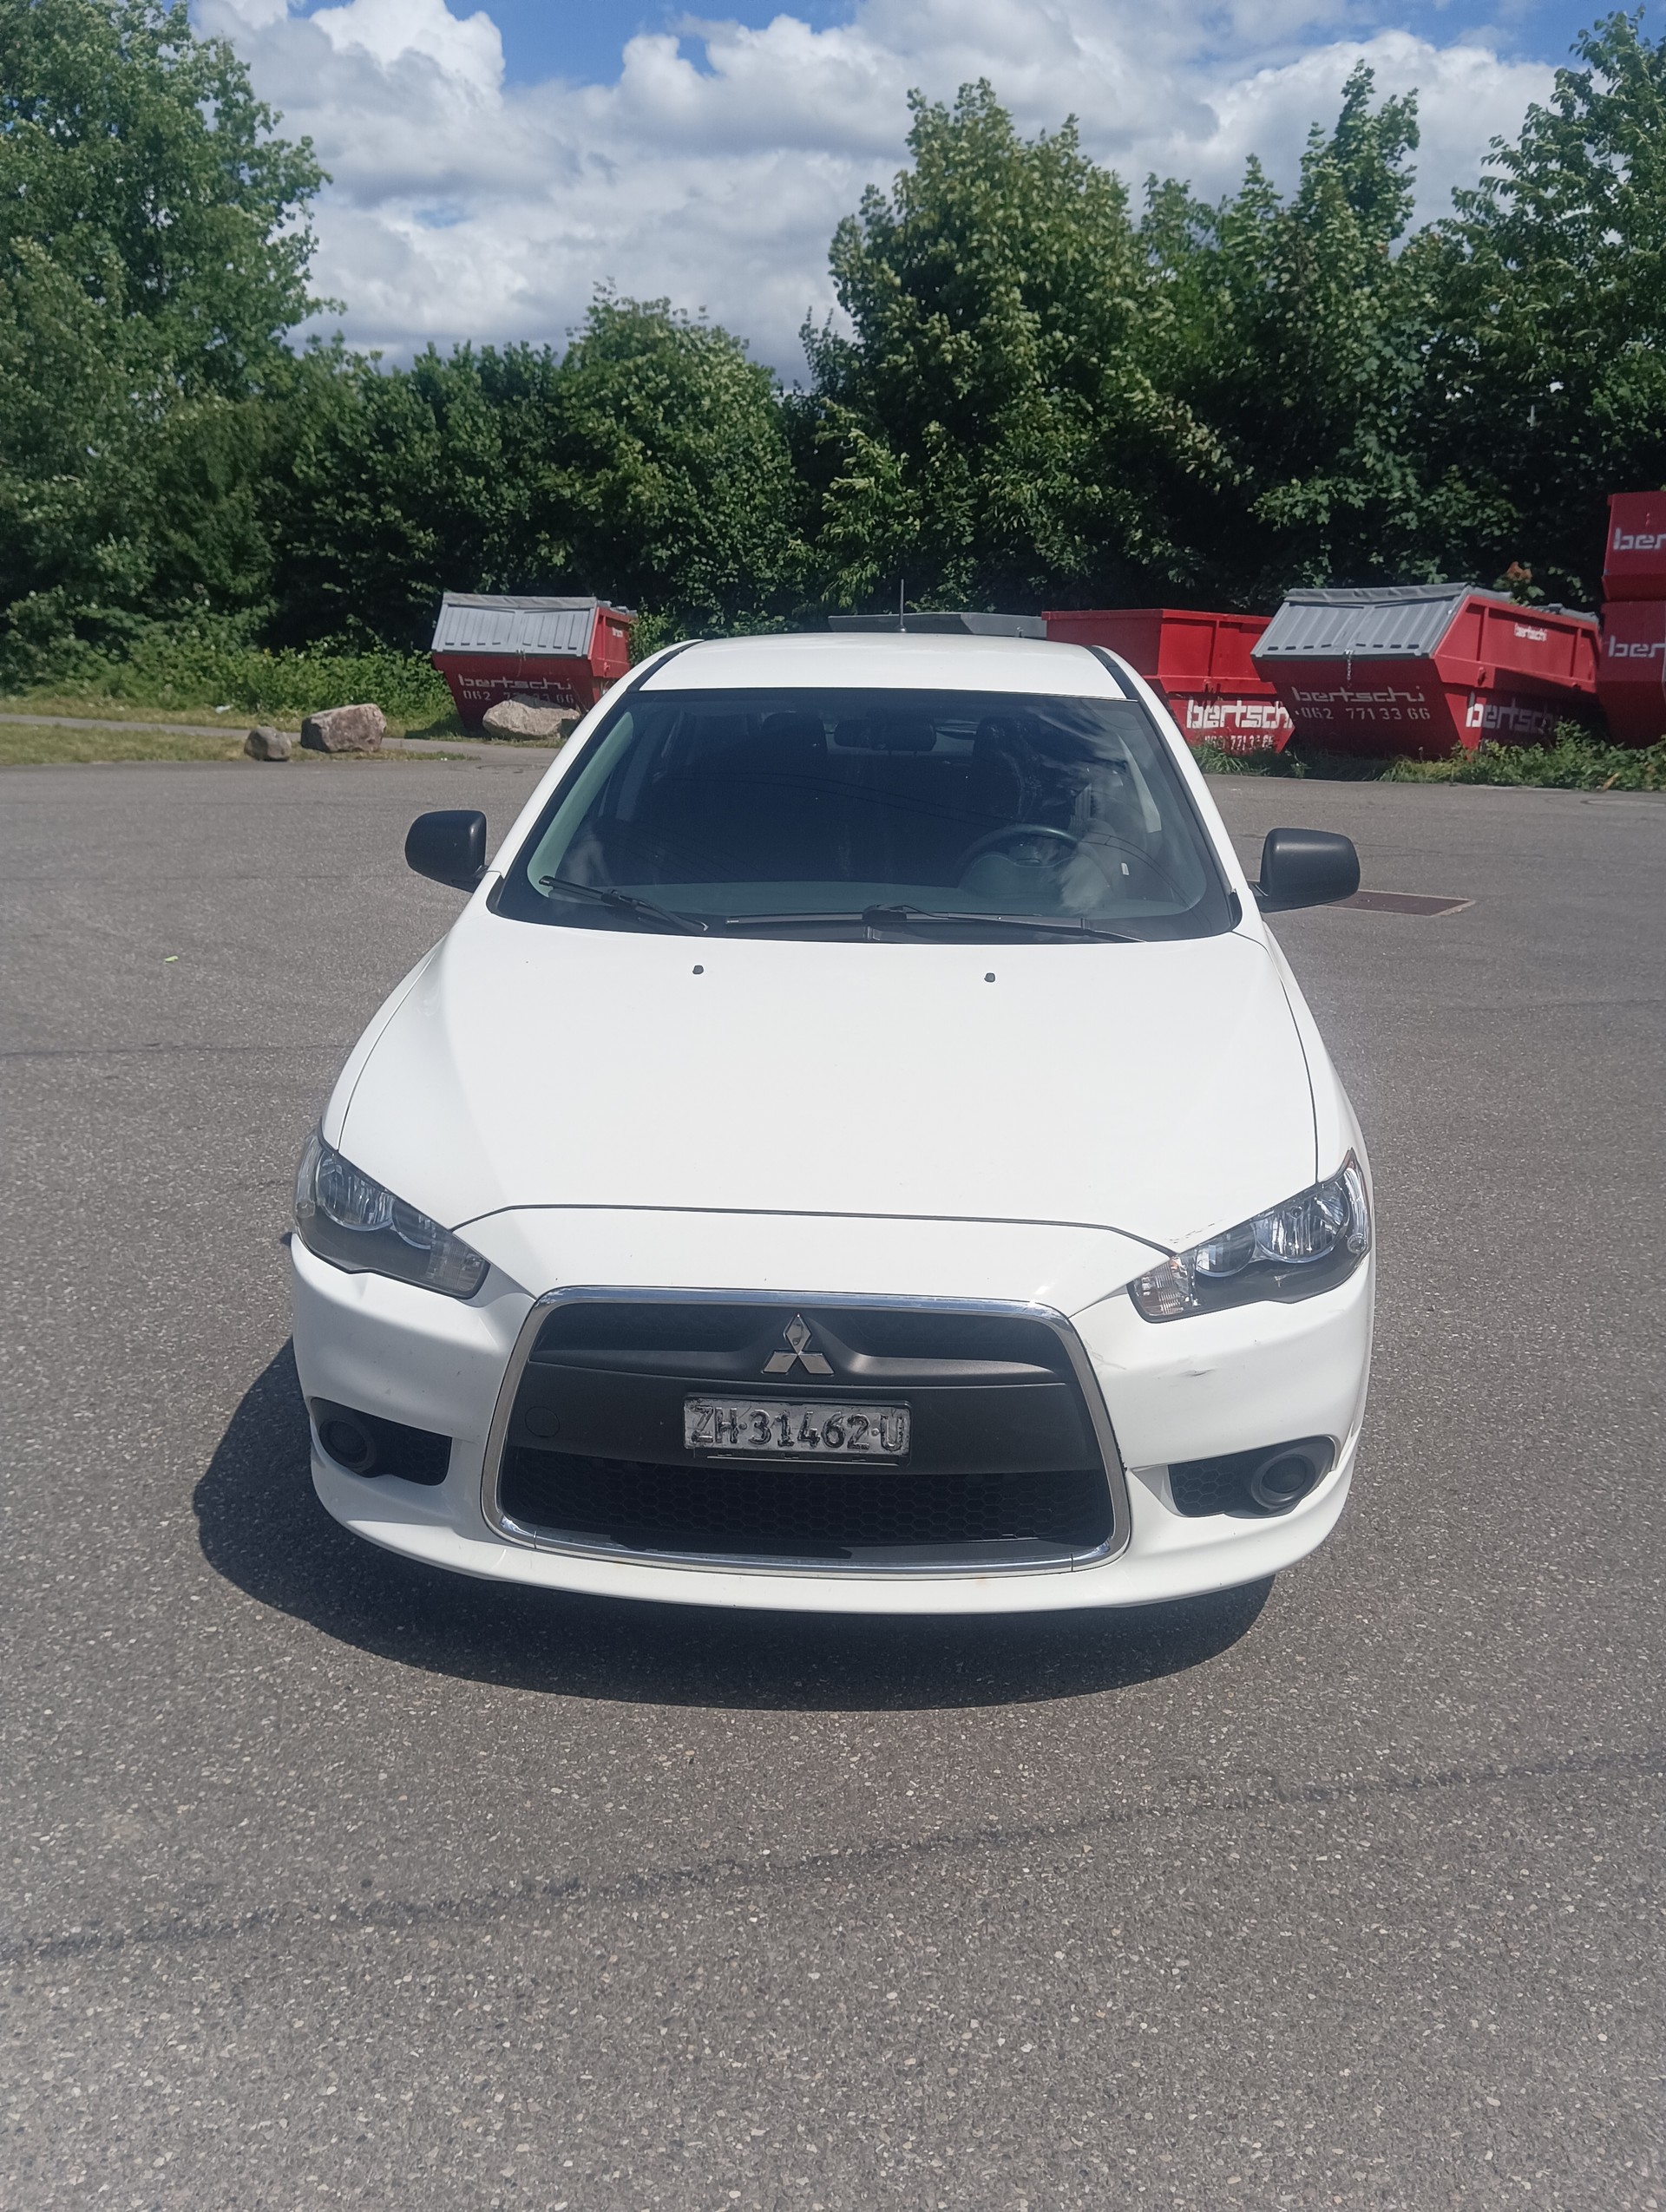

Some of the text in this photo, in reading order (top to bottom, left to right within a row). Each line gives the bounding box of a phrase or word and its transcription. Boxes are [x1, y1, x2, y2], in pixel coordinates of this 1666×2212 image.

[458, 673, 572, 690] bertschi
[462, 690, 491, 701] 062
[1291, 685, 1425, 702] bertschi
[1301, 707, 1430, 720] 062 771 33 66
[1466, 690, 1560, 734] bertsch
